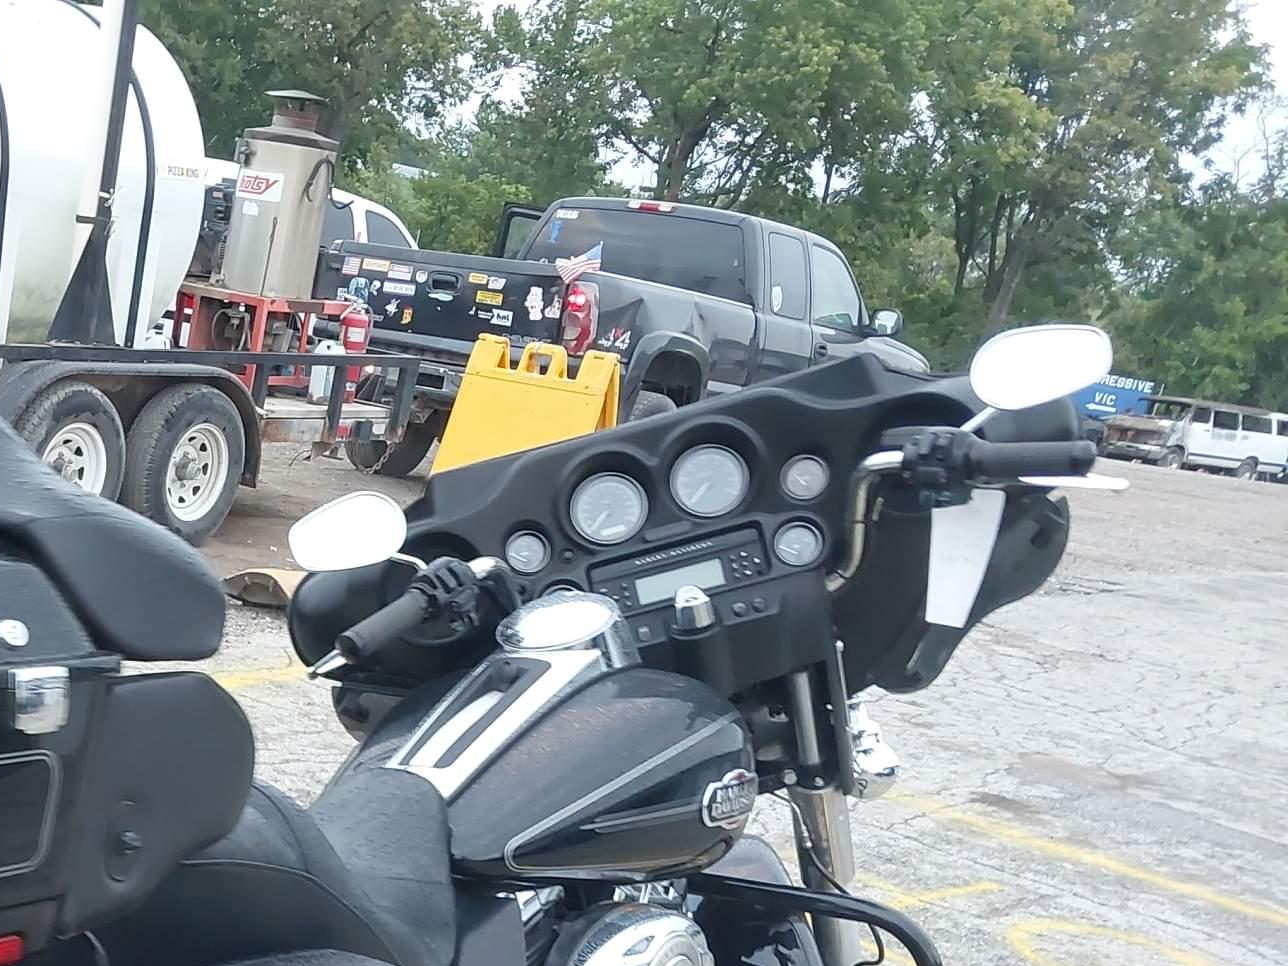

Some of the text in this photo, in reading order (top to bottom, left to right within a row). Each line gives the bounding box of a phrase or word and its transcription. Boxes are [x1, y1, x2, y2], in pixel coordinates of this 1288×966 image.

[167, 165, 199, 178] PIZZA KING
[1096, 374, 1155, 394] RESSIVE
[1094, 391, 1117, 406] VIC
